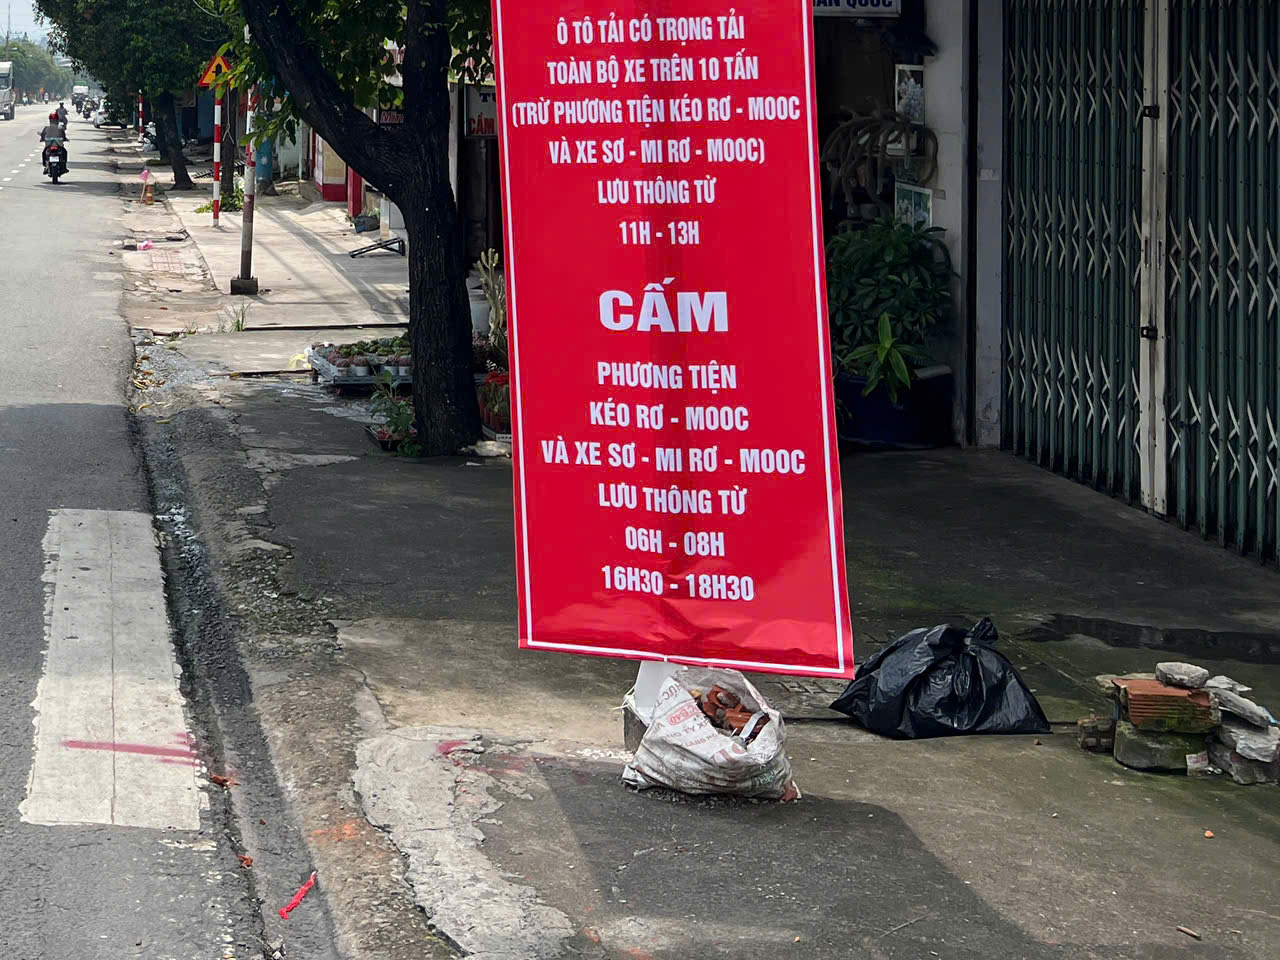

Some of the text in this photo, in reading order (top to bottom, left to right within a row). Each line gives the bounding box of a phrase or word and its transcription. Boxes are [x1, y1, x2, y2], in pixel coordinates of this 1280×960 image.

[558, 8, 744, 45] Ô TÔ TẢI CÓ TRỌNG TẢI
[548, 48, 758, 88] TOÀN BỘ XE TRÊN 10 TẤN
[513, 94, 800, 127] (TRỪ PHƯƠNG TIỆN KÉO RƠ MOOC
[549, 137, 764, 163] VÀ XE SƠ MI RƠ MOOC)
[598, 175, 716, 203] LƯU THÔNG TỪ
[620, 221, 699, 244] 11H 13H
[600, 278, 728, 332] CẤM
[598, 360, 736, 393] PHƯƠNG TIỆN
[590, 398, 748, 430] KÉO RƠ MOOC
[542, 436, 805, 474] VÀ XE SƠ MI RƠ MOOC
[599, 483, 747, 514] LƯU THÔNG TỪ
[626, 527, 724, 556] 06H 08H
[602, 566, 754, 600] 16H30 18H30
